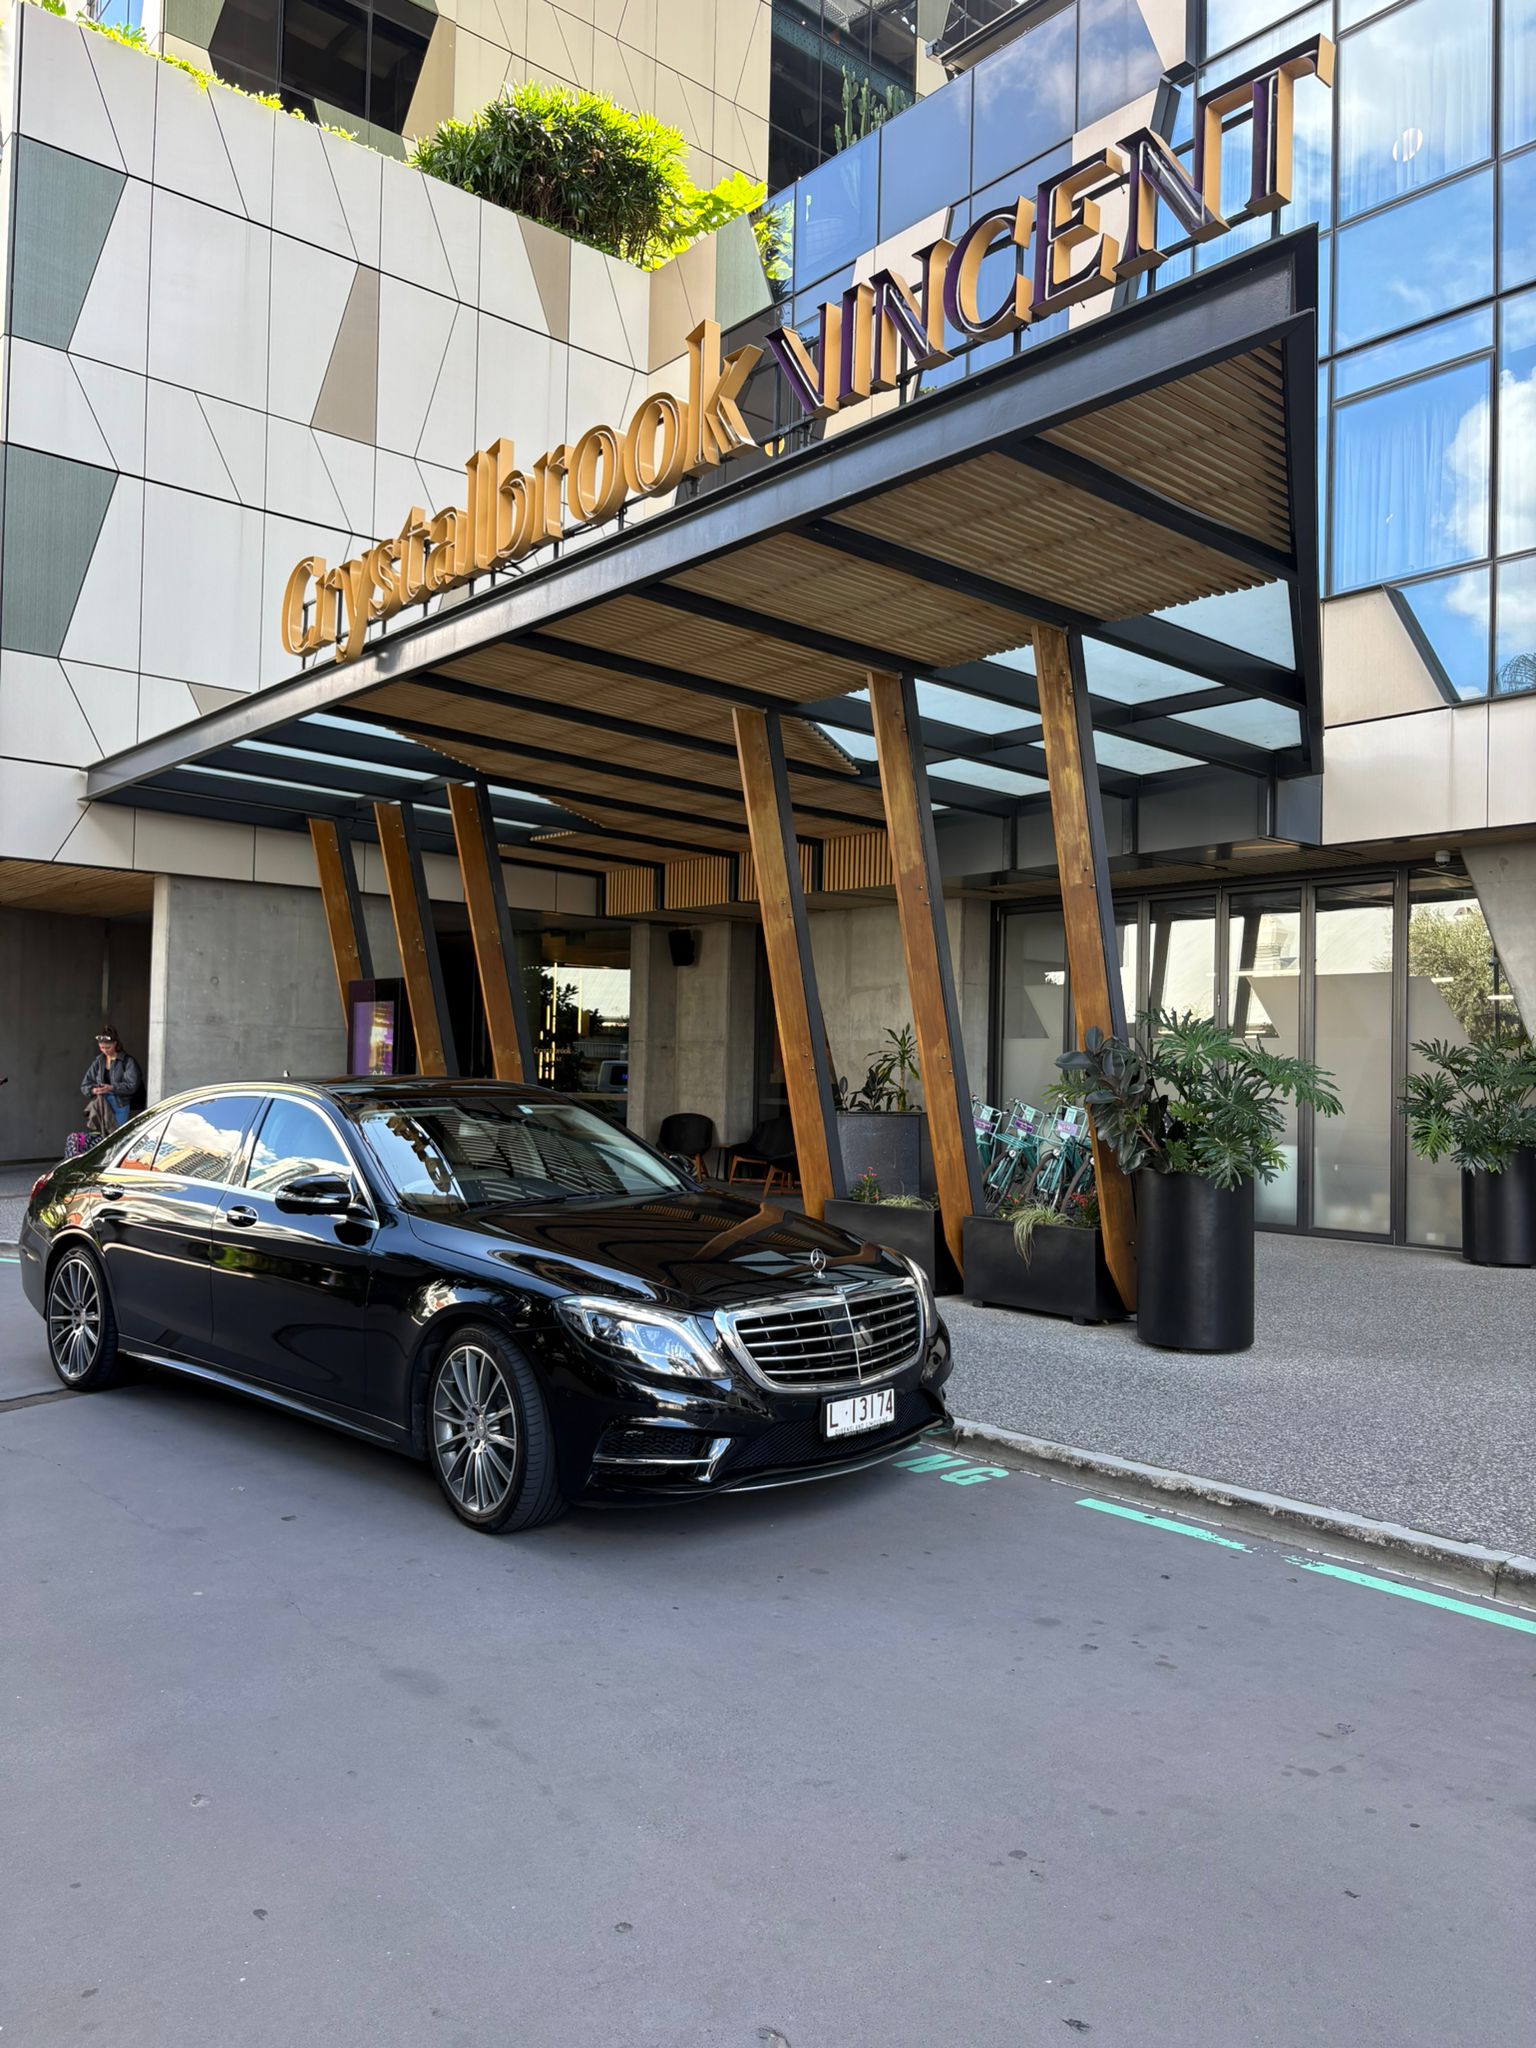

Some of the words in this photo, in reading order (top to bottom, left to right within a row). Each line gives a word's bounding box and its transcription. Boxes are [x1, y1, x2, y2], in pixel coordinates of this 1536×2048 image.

[281, 318, 764, 664] Crystalbrook
[764, 33, 1336, 419] VINCENT
[852, 1390, 893, 1424] 13174
